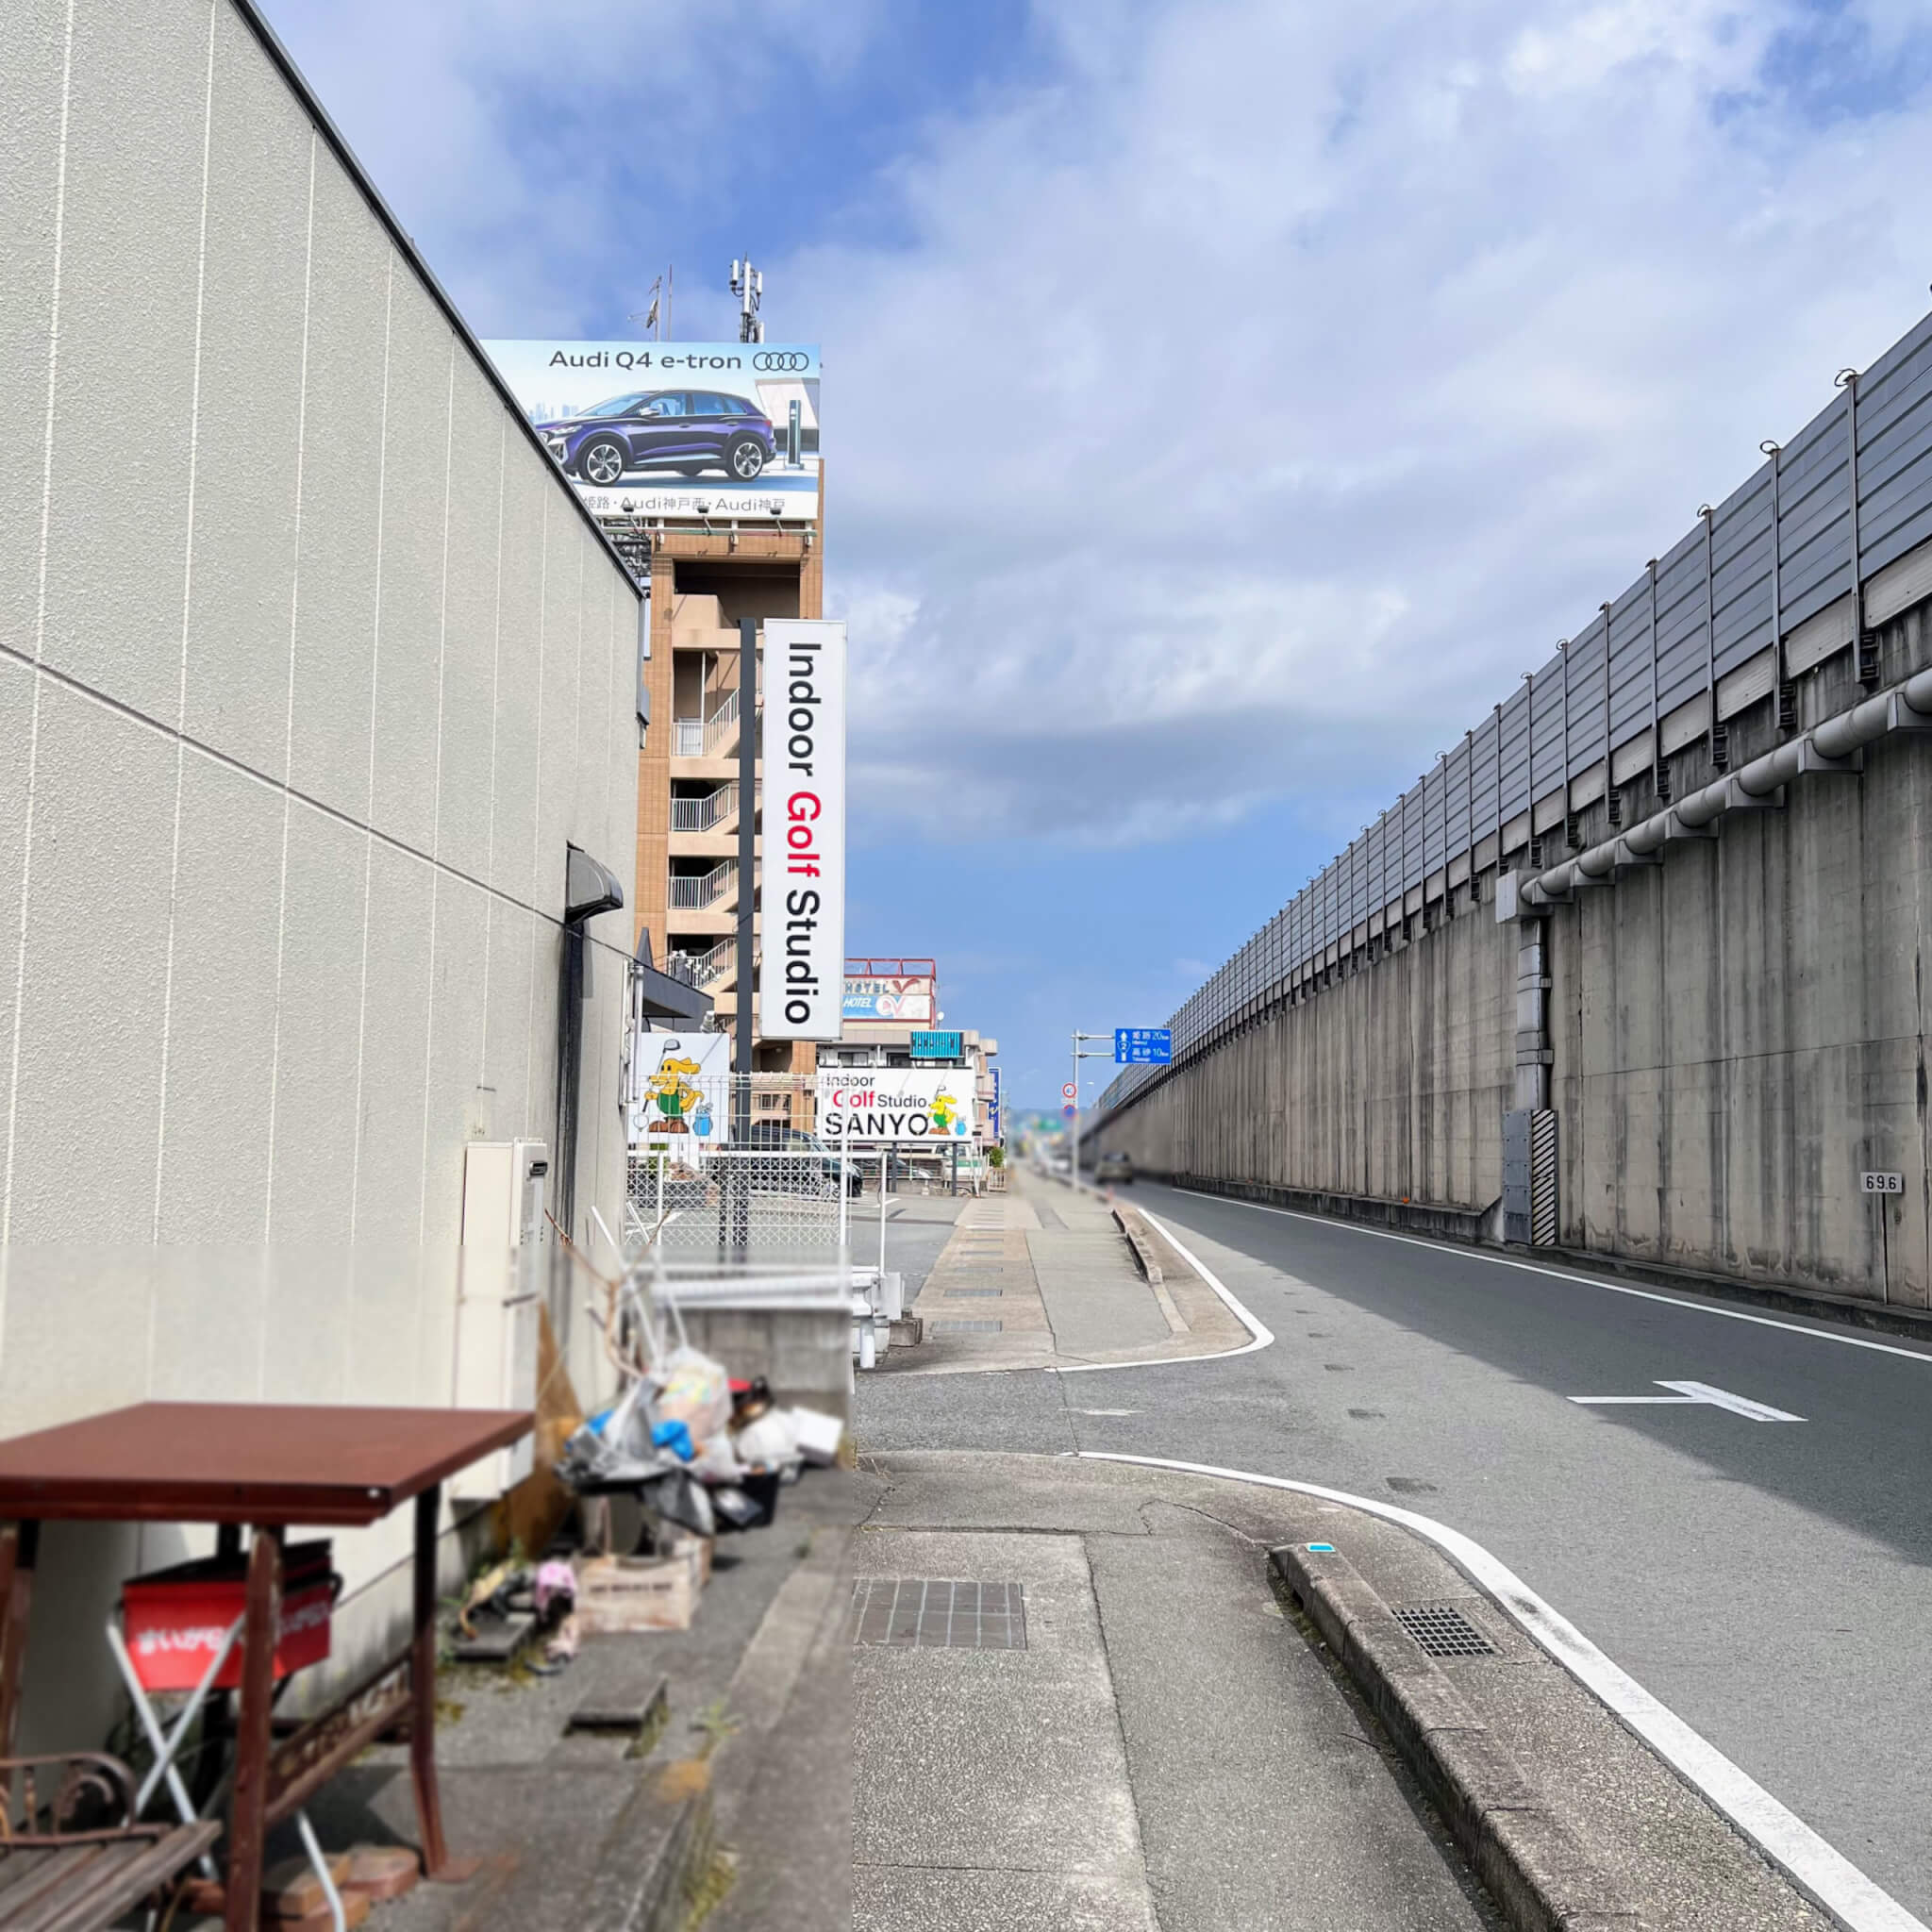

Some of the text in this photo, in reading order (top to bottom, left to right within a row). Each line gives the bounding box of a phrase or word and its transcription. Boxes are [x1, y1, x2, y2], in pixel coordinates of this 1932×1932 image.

[549, 350, 741, 370] Audi Q4 e-tron
[784, 642, 822, 1024] Indoor Golf Studio
[844, 982, 890, 993] HOTEL
[843, 997, 872, 1008] HOTEL
[877, 1093, 927, 1108] Studio
[824, 1112, 929, 1136] SANYO
[1867, 1175, 1896, 1190] 69.6
